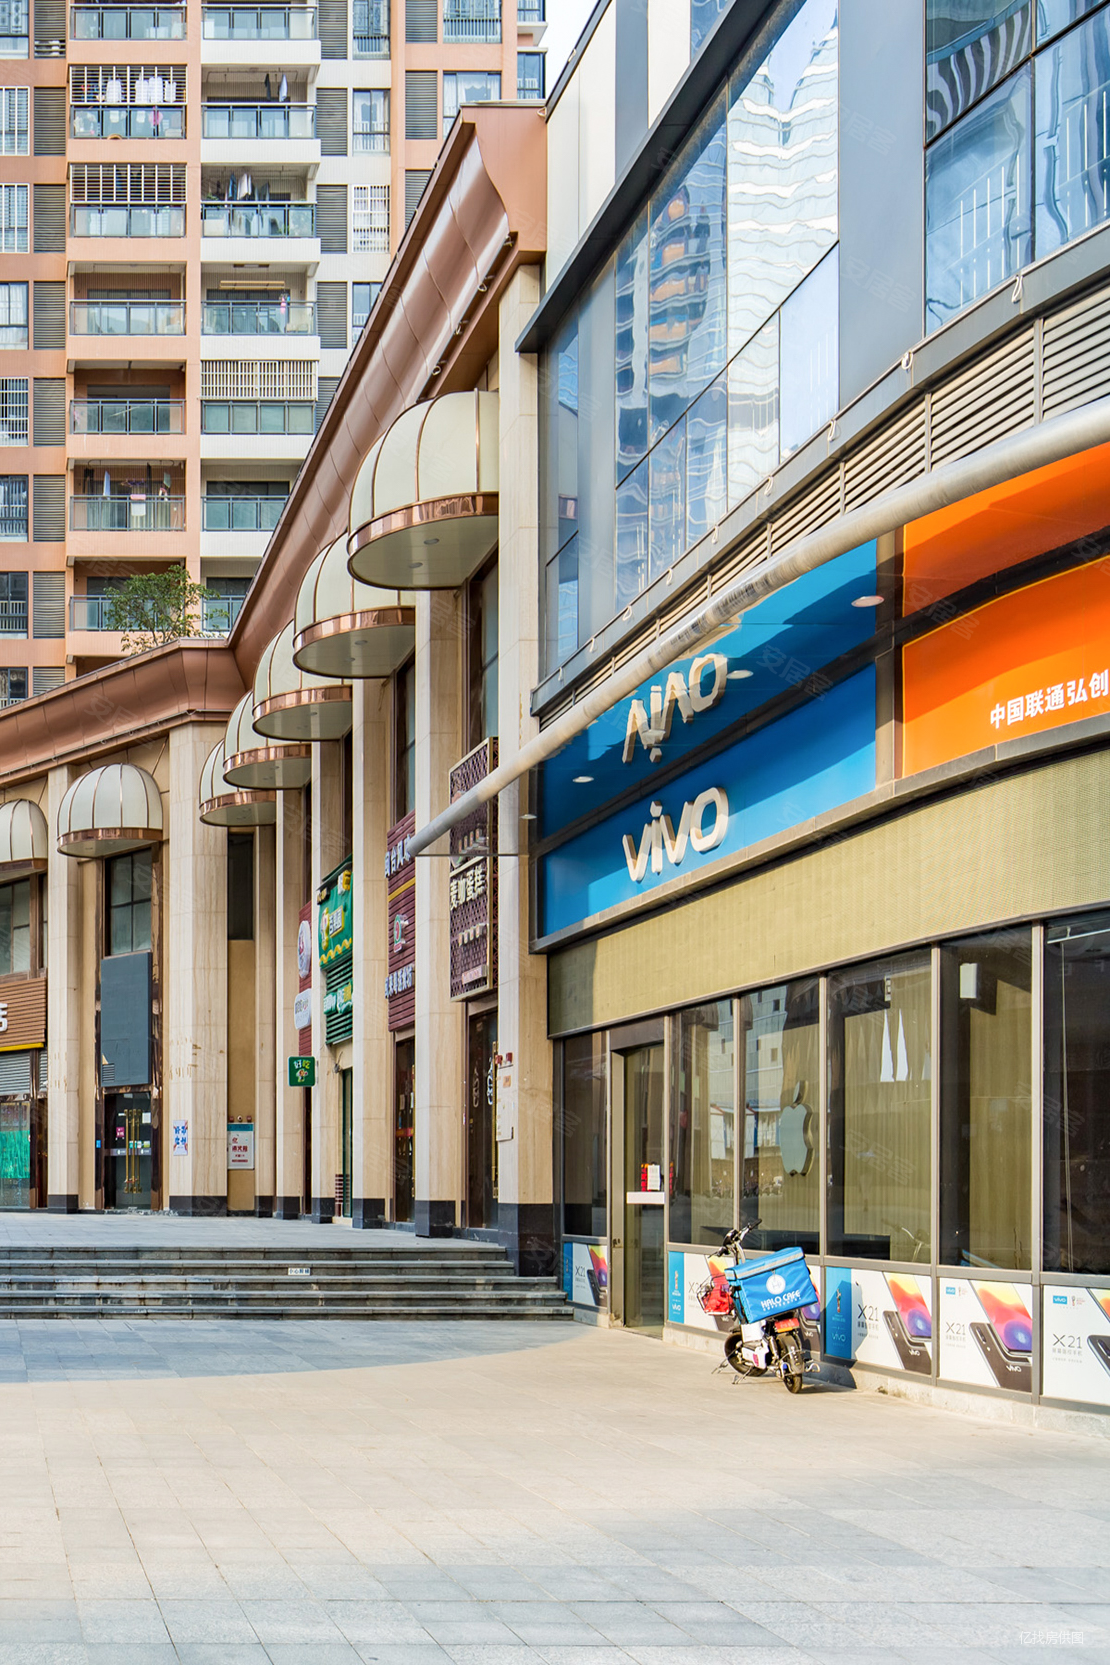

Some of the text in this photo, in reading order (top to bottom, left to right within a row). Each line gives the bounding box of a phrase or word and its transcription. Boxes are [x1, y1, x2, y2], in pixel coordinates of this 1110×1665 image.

[990, 669, 1109, 729] 中国联通弘创
[622, 787, 729, 882] vivo
[575, 1265, 586, 1278] X21
[760, 1296, 782, 1310] HALO
[782, 1289, 801, 1301] CAFE
[857, 1303, 879, 1322] X21
[831, 1332, 846, 1342] vivo
[945, 1321, 966, 1336] X21
[1052, 1333, 1083, 1350] X21
[1005, 1365, 1022, 1373] vivo
